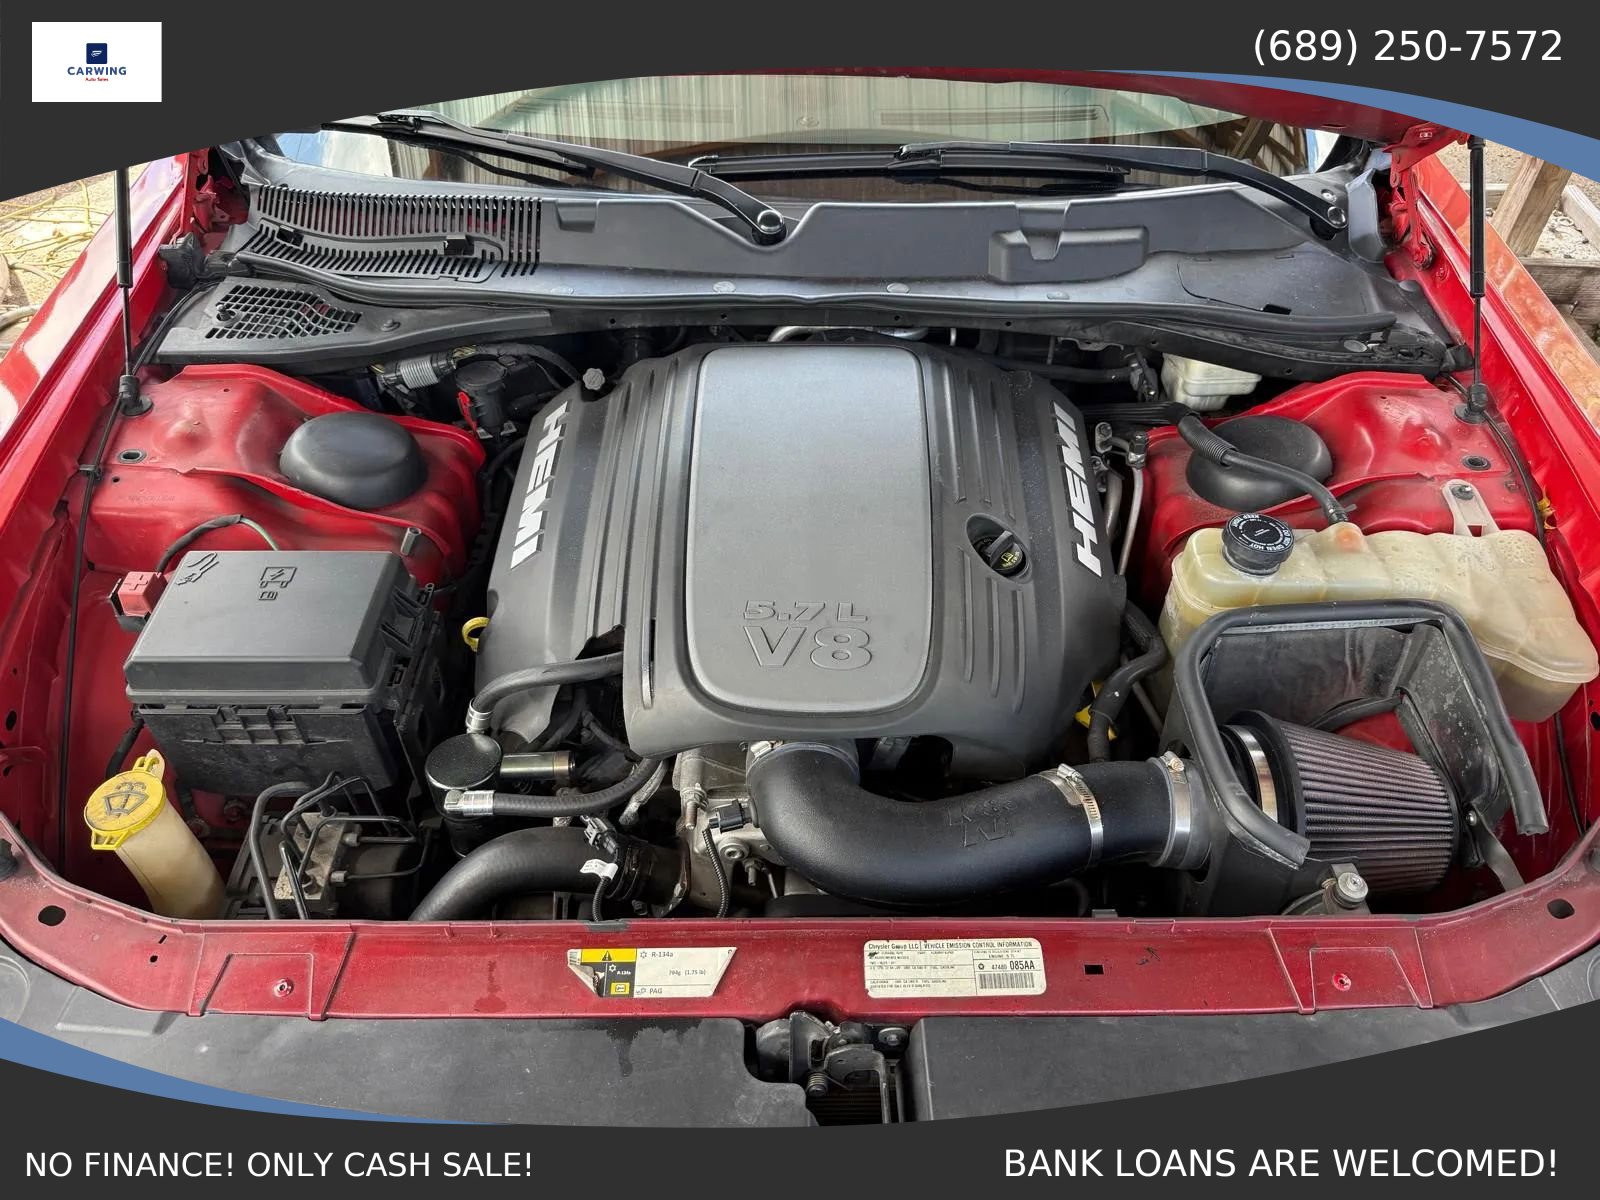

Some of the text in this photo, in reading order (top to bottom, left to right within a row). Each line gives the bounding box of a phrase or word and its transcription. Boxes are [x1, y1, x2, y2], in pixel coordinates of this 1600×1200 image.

[510, 401, 569, 570] HEMI
[1053, 401, 1102, 577] HEMI
[743, 625, 873, 671] V8
[868, 943, 890, 951] Chrysler
[891, 943, 908, 951] Group
[972, 941, 996, 949] CONTROL
[1009, 960, 1036, 970] 085AA
[649, 987, 663, 995] PAG
